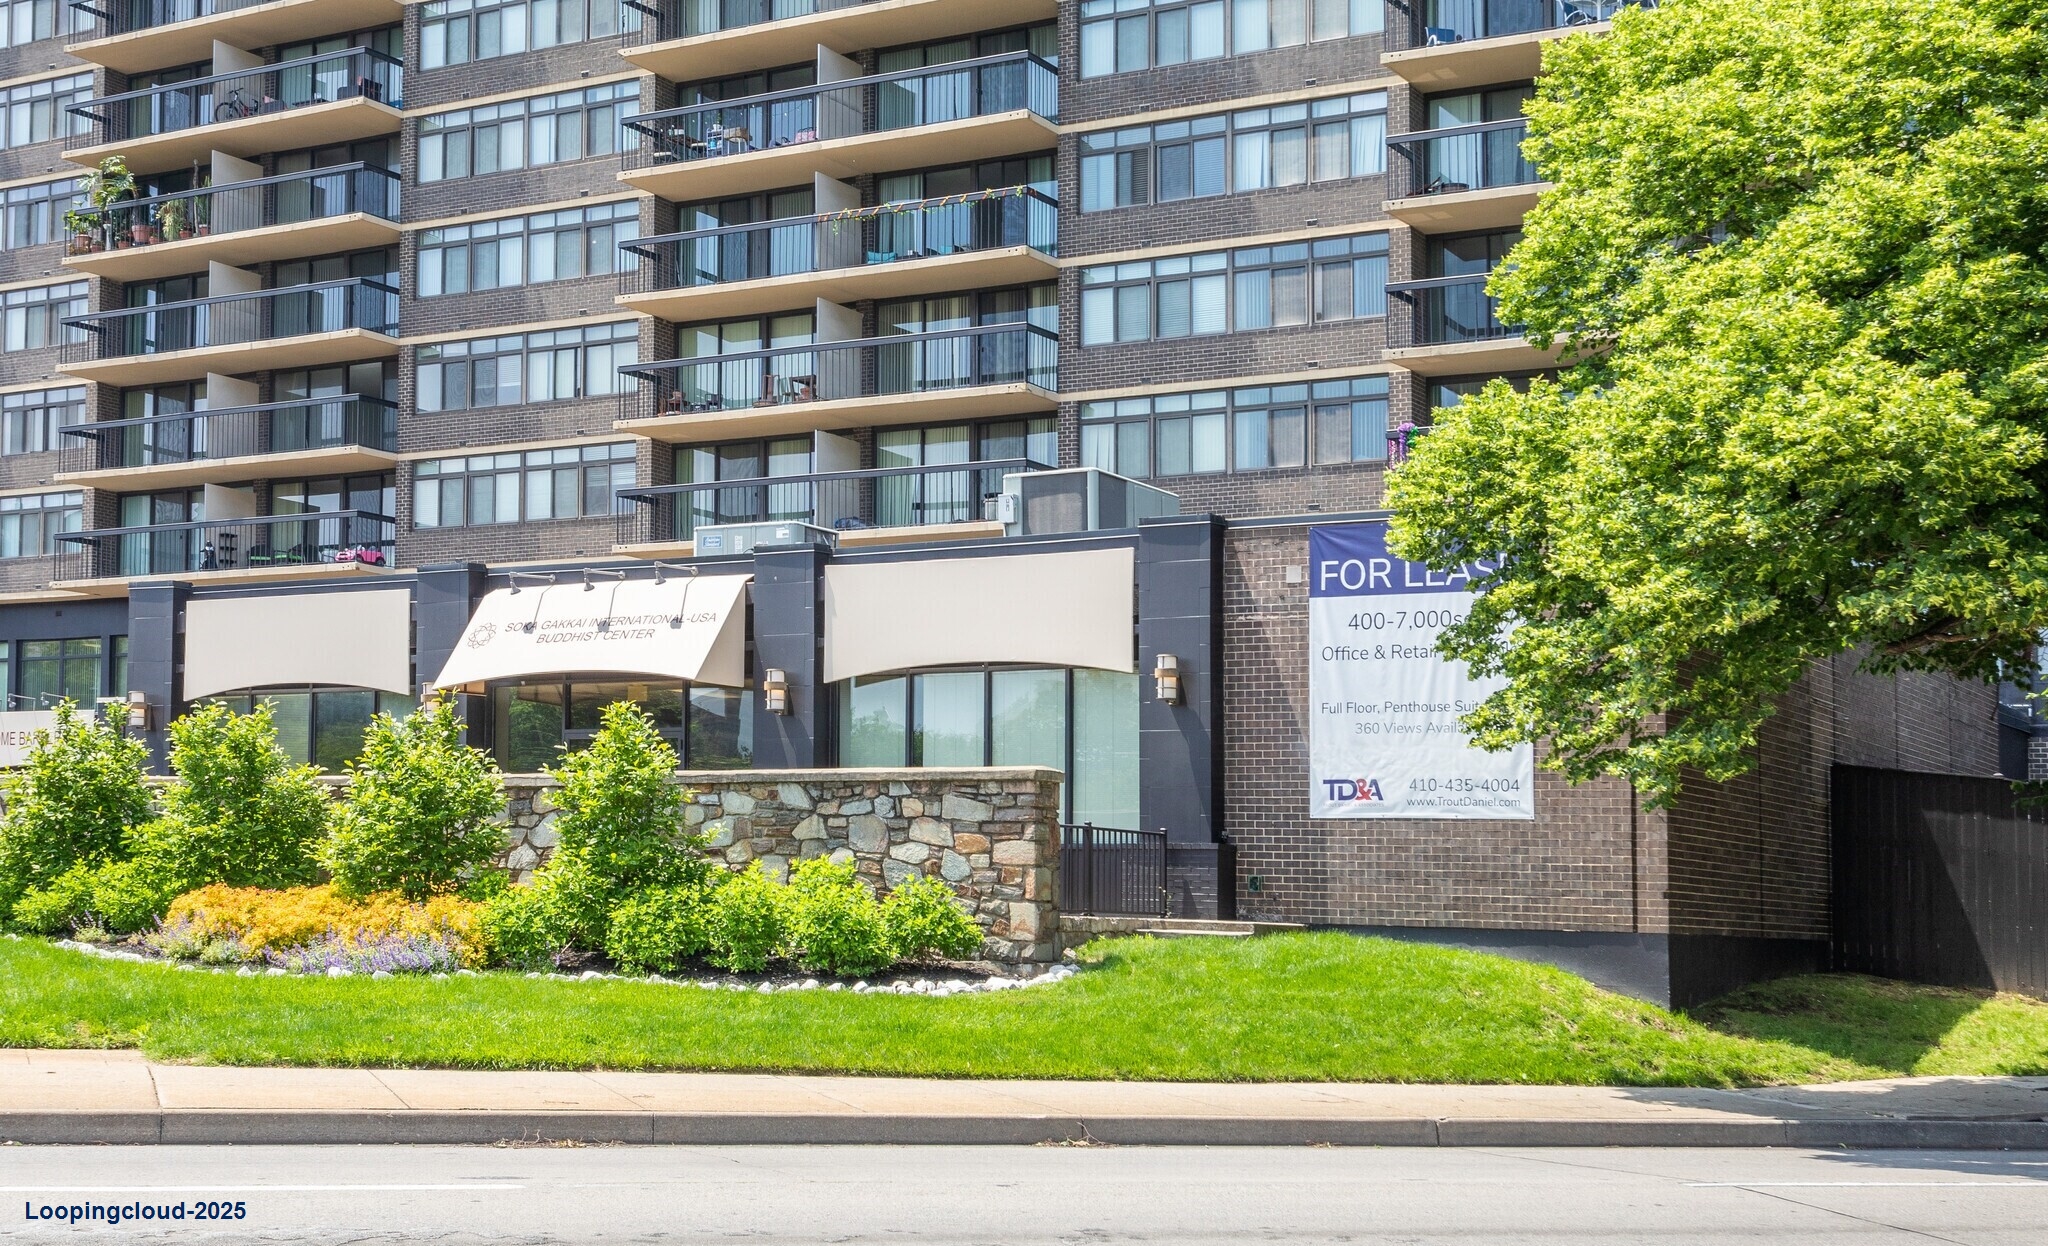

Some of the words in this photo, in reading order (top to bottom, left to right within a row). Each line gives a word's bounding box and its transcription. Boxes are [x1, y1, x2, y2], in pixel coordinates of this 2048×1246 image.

[1321, 558, 1392, 591] FOR
[504, 621, 538, 633] SOKA
[541, 619, 587, 630] GAKKAI
[536, 631, 600, 644] BUDDHIST
[603, 629, 655, 640] CENTER
[1322, 646, 1369, 661] Office
[1375, 645, 1386, 660] &
[1321, 702, 1343, 714] Full
[1346, 701, 1380, 714] Floor,
[1384, 701, 1451, 713] Penthouse
[1355, 722, 1380, 734] 360
[1383, 722, 1422, 734] Views
[1323, 778, 1384, 801] TD&A
[1409, 778, 1520, 792] 410-435-4004
[1406, 797, 1521, 808] www.TroutDaniel.com
